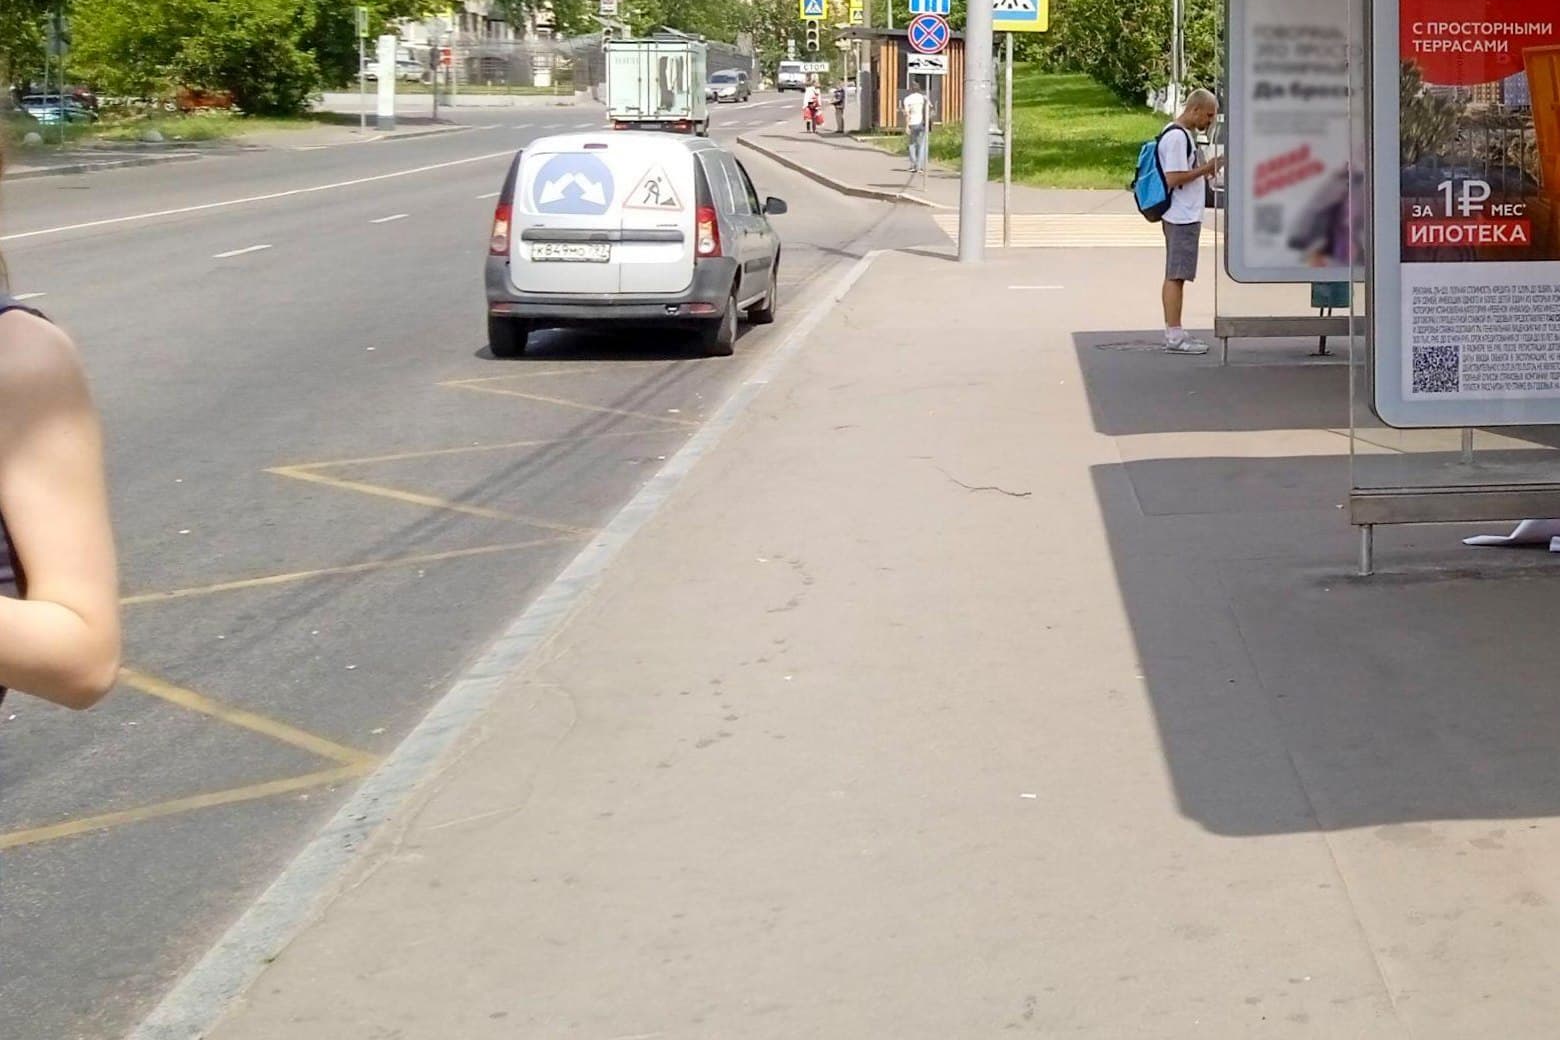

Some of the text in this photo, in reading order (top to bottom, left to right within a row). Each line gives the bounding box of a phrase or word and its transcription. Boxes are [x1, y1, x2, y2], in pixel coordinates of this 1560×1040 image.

[1412, 21, 1553, 36] С ПРОСТОРНЫМИ
[1411, 39, 1509, 53] ТЕРРАСАМИ
[1411, 204, 1434, 217] ЗА
[1411, 224, 1528, 243] ИПОТЕКА
